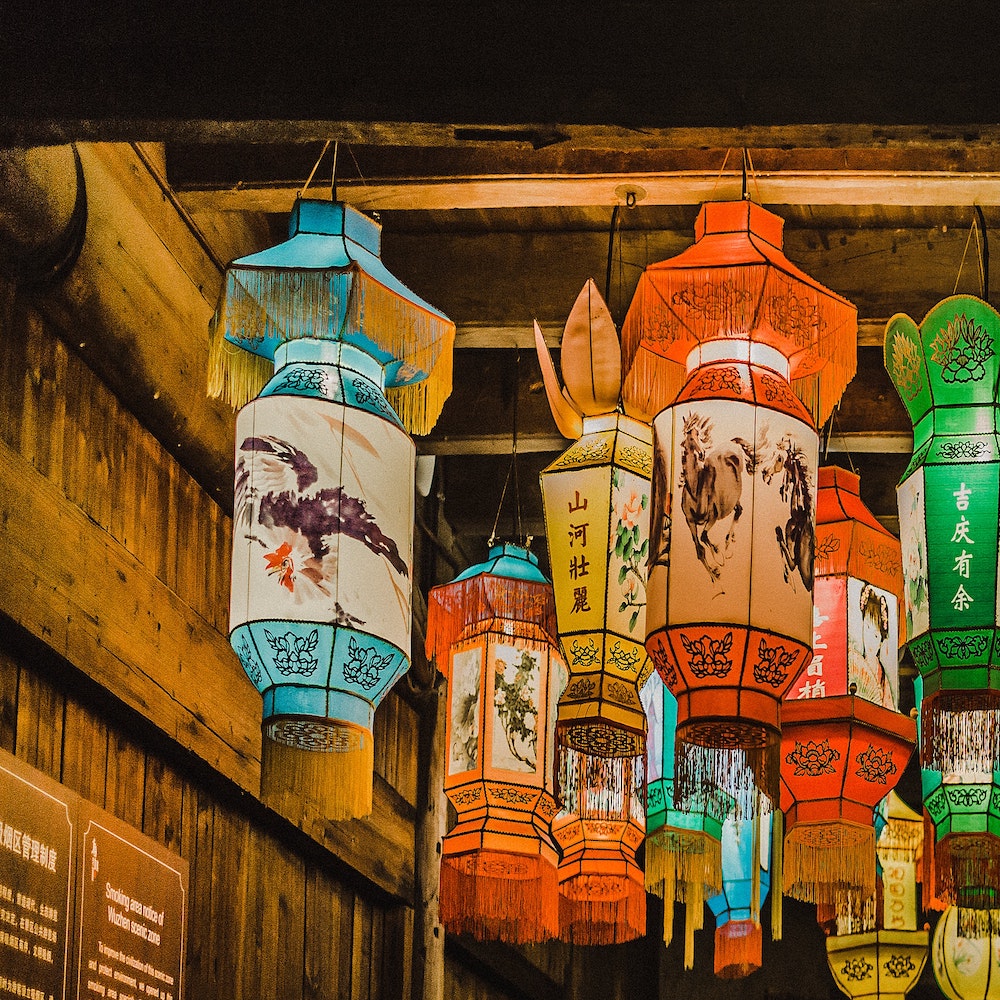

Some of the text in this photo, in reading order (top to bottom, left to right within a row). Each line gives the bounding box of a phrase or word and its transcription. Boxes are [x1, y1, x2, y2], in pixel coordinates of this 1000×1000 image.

[951, 483, 974, 611] 吉庆有余
[105, 882, 129, 912] Smoking
[130, 899, 142, 915] area
[143, 905, 158, 923] notice
[108, 905, 160, 946] Wuzhen scenic zone
[107, 988, 117, 999] area
